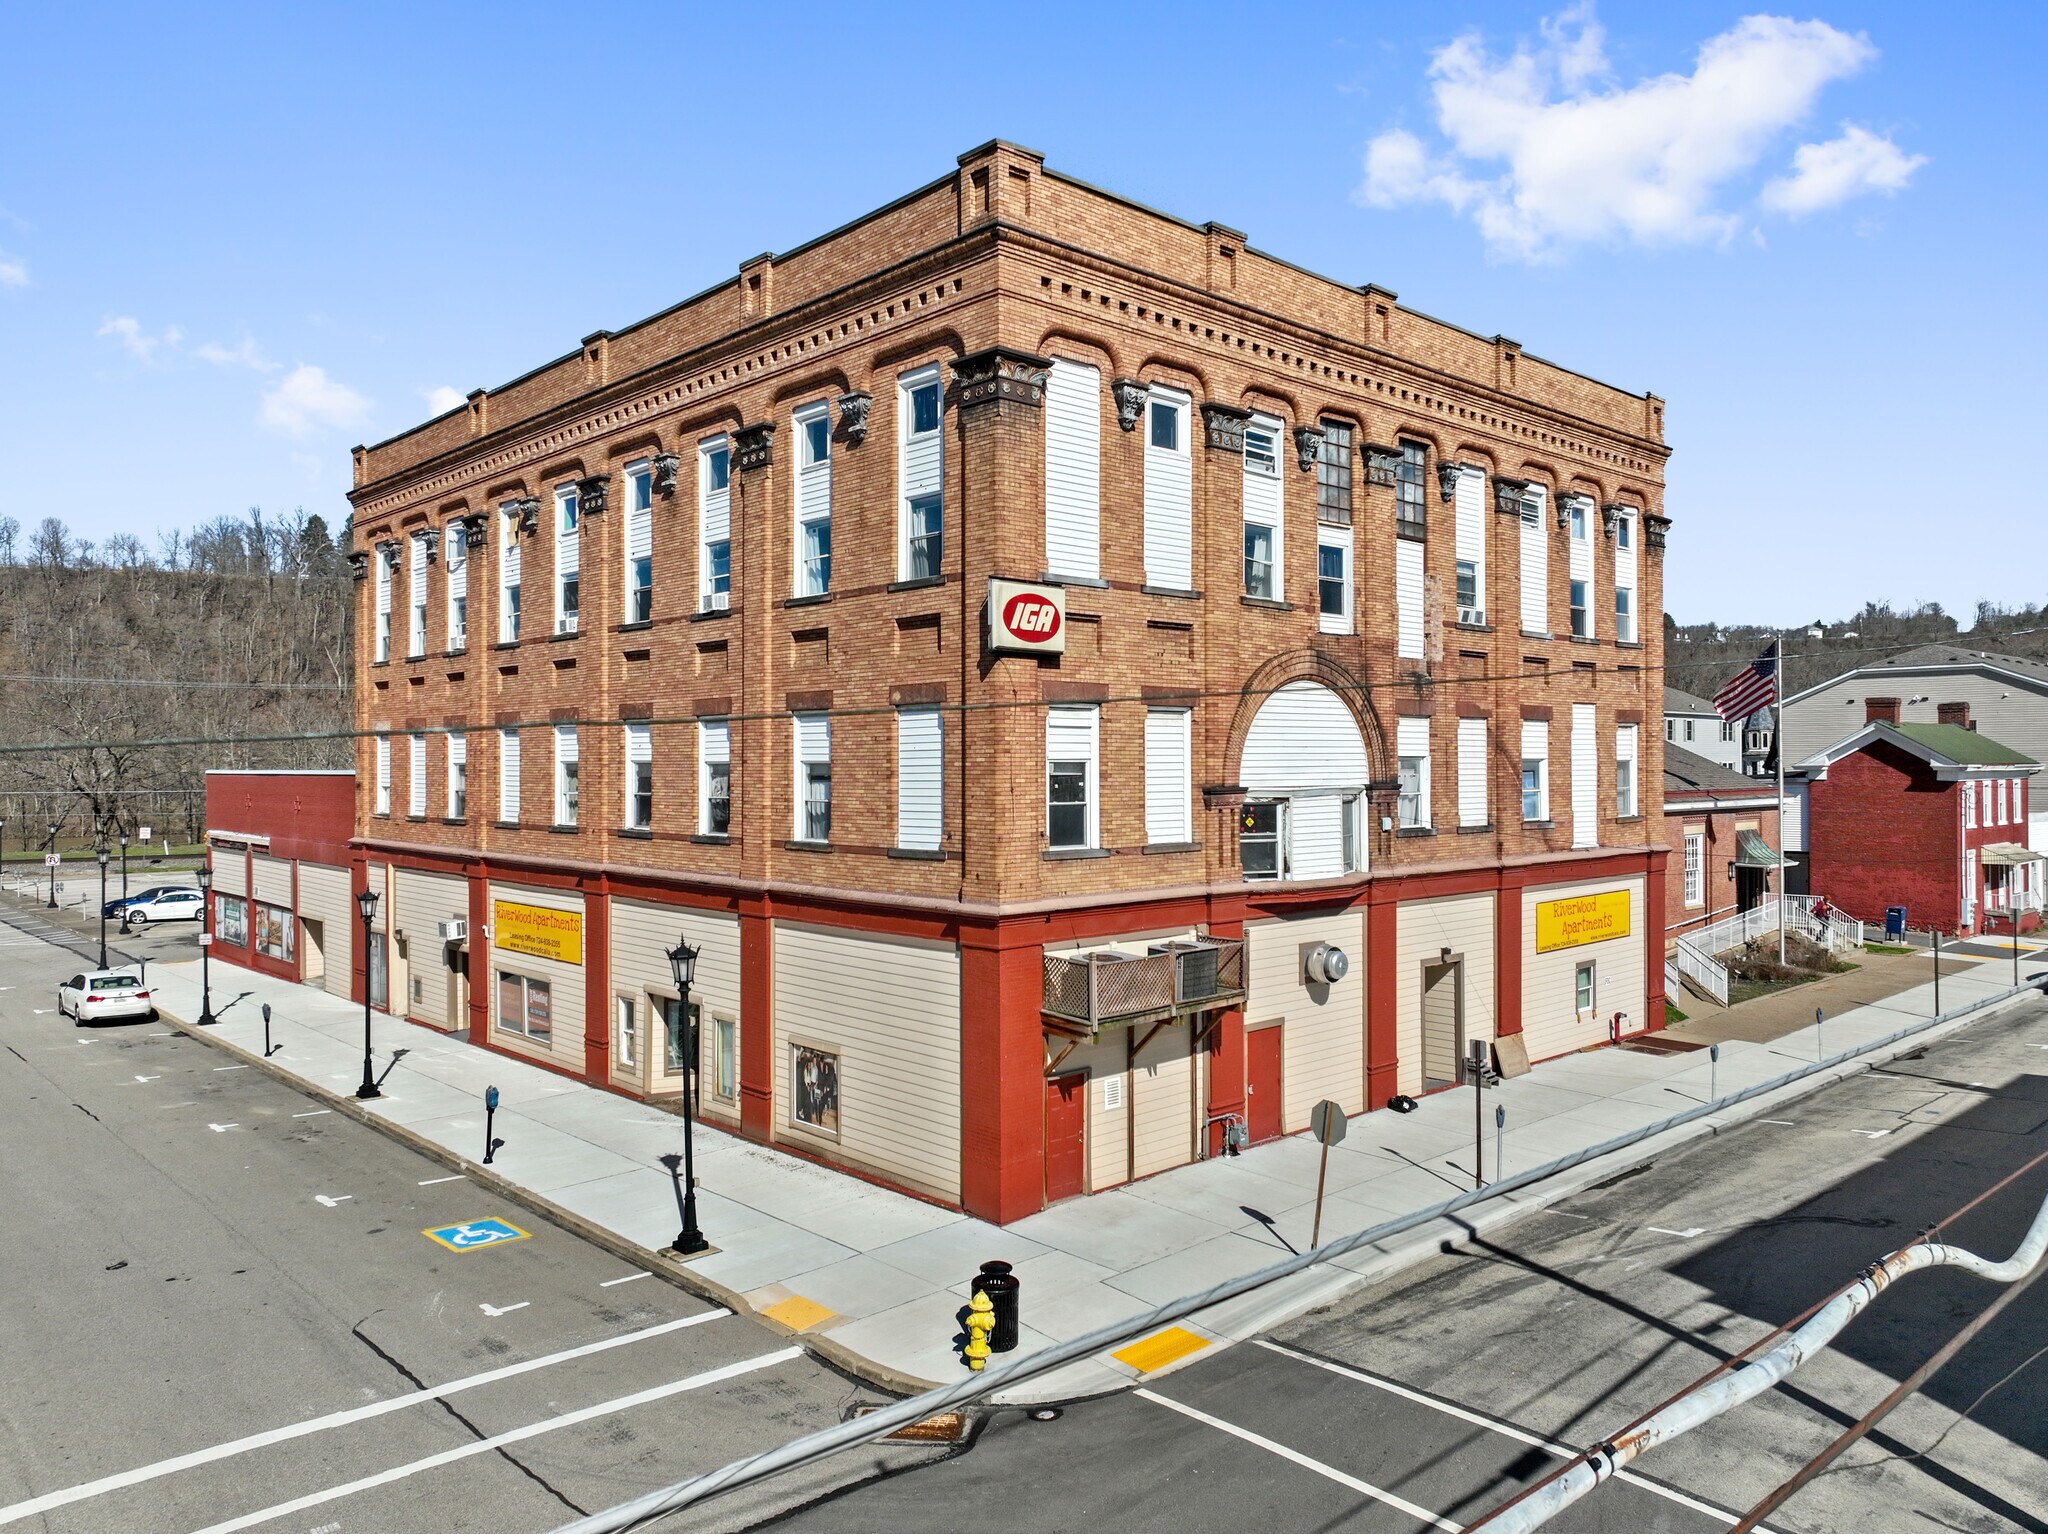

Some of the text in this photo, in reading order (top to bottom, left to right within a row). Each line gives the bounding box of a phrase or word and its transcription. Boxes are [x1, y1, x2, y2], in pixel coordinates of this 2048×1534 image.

[1009, 602, 1056, 632] IGA
[496, 904, 580, 932] RiverWood Apartments
[1553, 895, 1597, 918] RiverWood
[1562, 912, 1613, 940] Apartments
